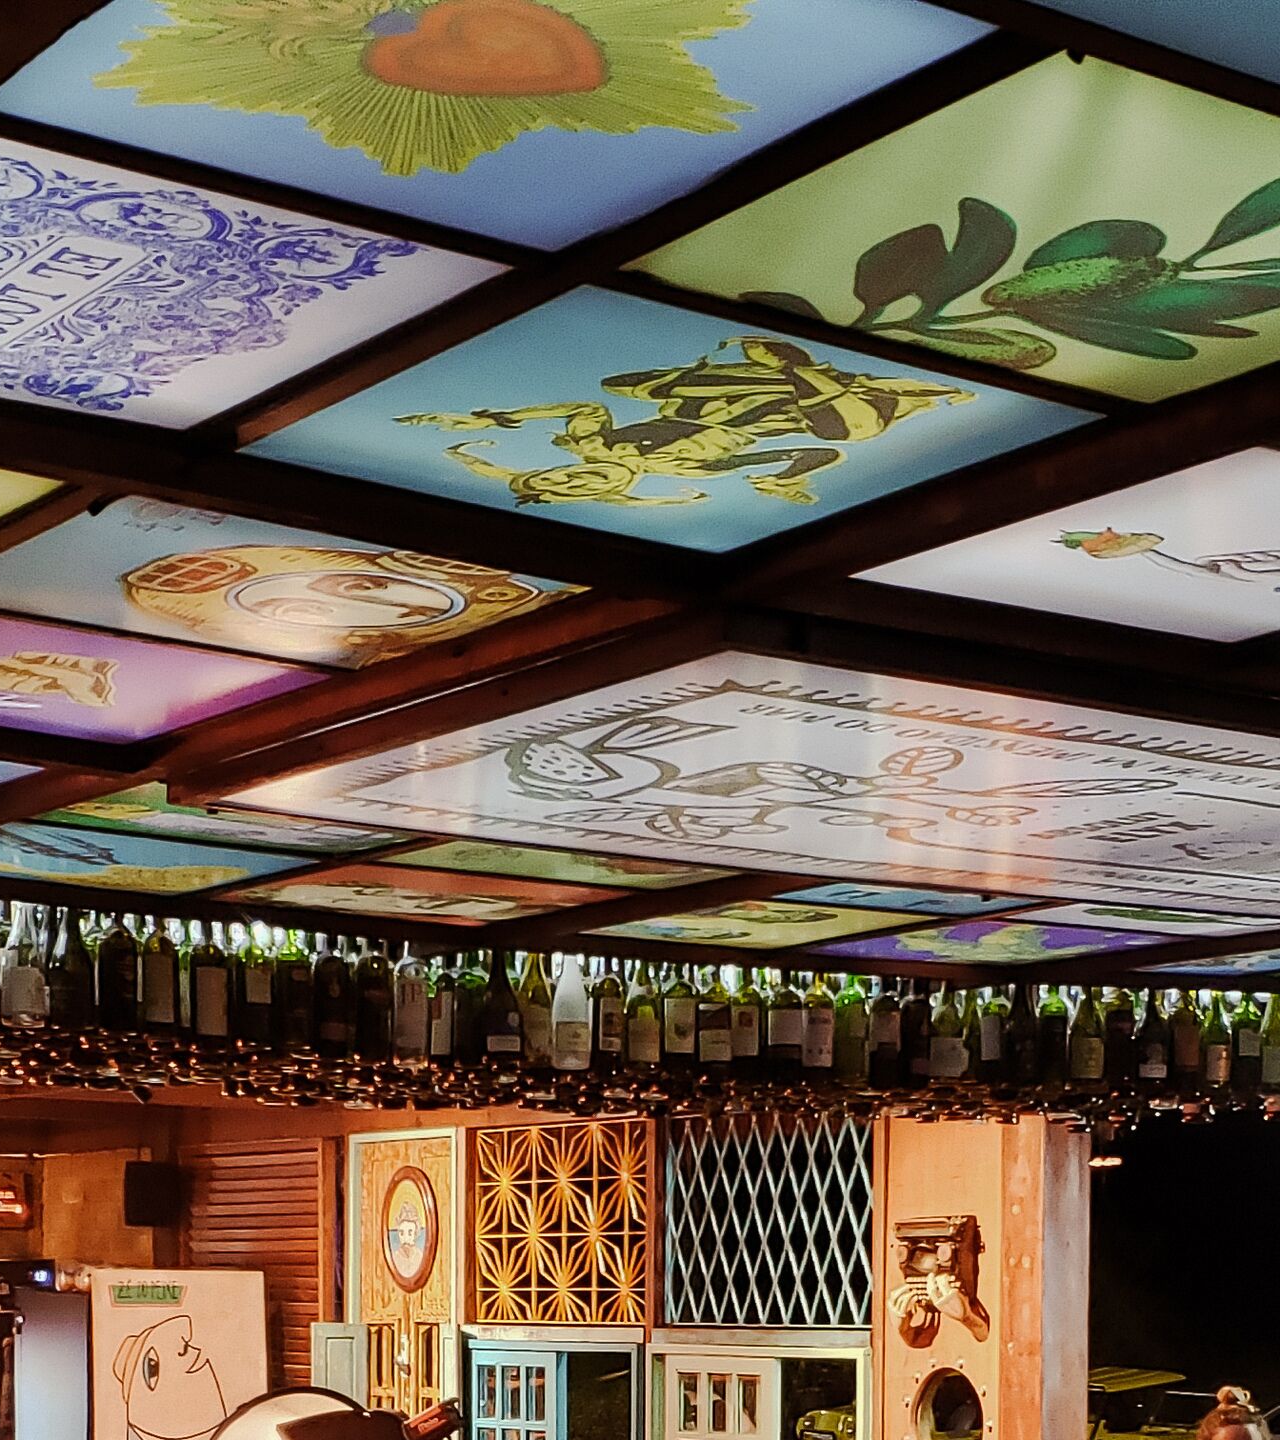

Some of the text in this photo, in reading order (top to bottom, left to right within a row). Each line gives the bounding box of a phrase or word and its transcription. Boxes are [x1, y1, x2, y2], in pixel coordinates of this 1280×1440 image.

[27, 246, 122, 280] EL
[737, 703, 837, 724] MAR
[833, 718, 899, 734] DO
